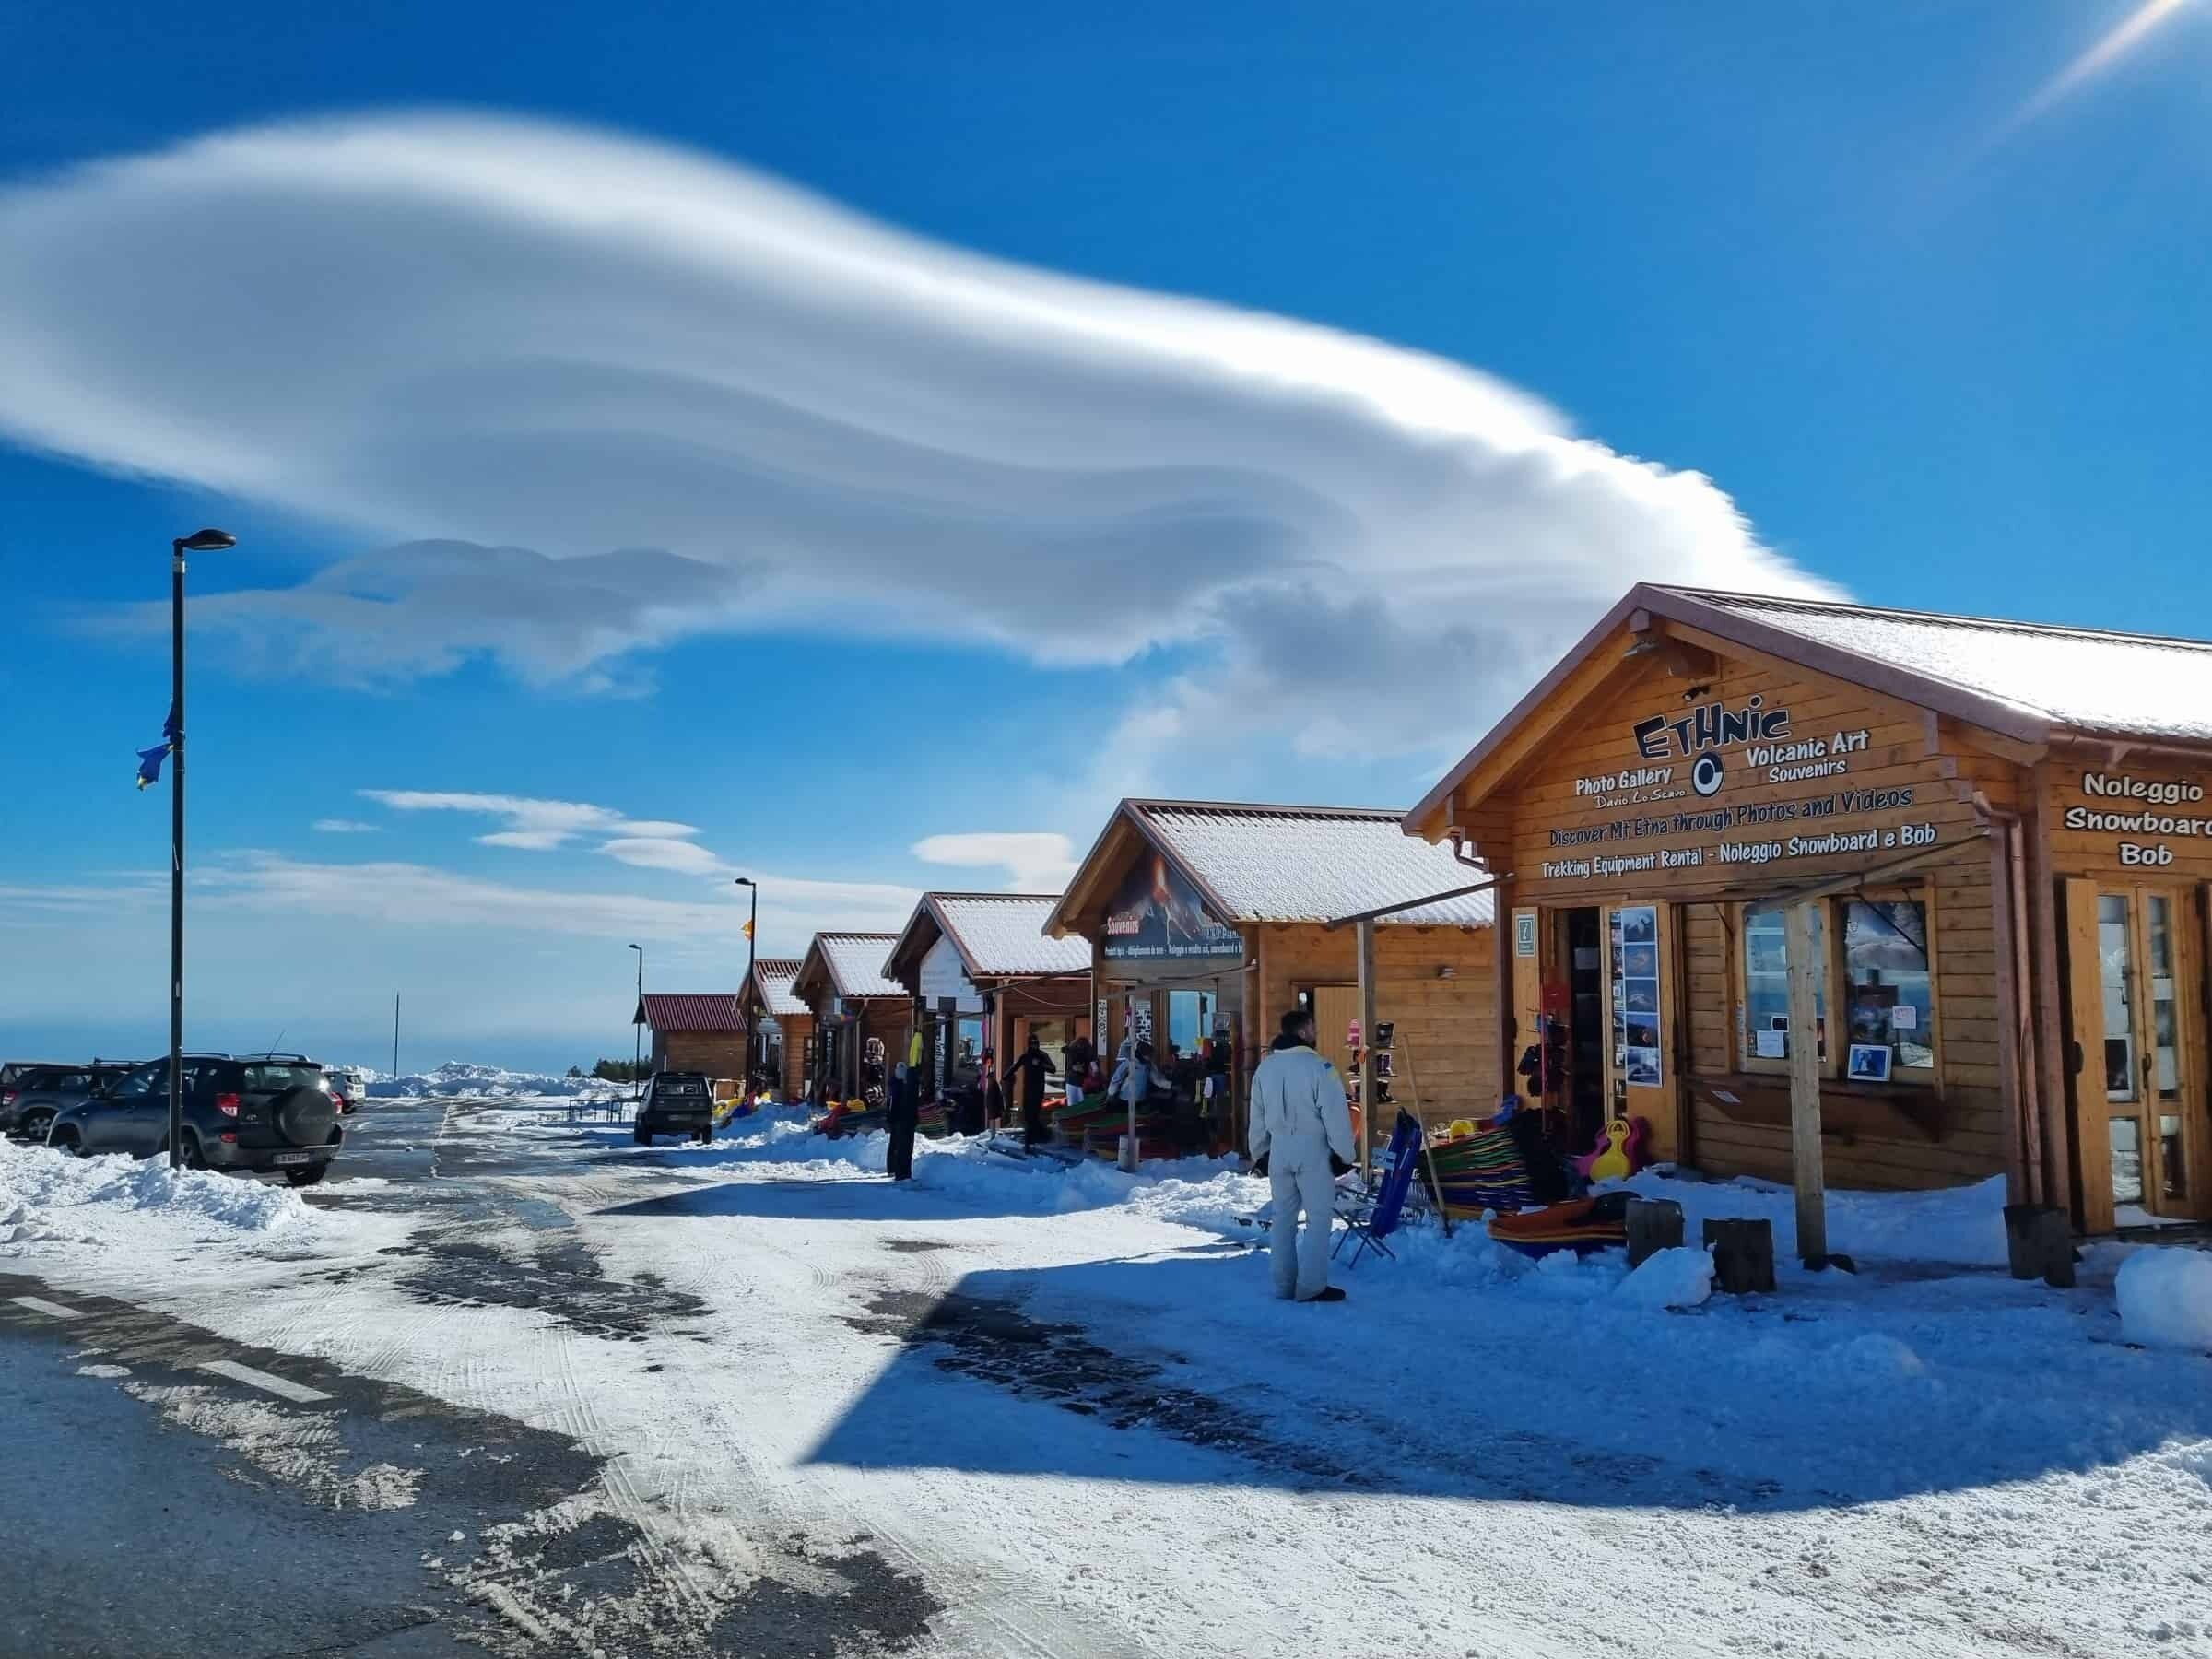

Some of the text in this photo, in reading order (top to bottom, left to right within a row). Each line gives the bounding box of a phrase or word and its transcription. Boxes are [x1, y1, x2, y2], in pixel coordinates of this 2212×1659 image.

[1747, 730, 1869, 768] Volcanic Art
[1575, 767, 1674, 796] Photo Gallery
[1769, 759, 1846, 783] Souvenirs
[2084, 773, 2204, 805] Noleggio
[1549, 787, 1913, 848] Discover Mt Etna through Photos and Videos
[1541, 859, 1590, 879] Trekking
[1594, 853, 1656, 876] Equipment
[1661, 847, 1703, 868] Rental
[1719, 840, 1782, 864] Noleggio
[1788, 829, 1878, 856] Snowboard
[1884, 831, 1896, 848] e
[1901, 823, 1936, 846] Bob
[2119, 842, 2174, 865] Bob
[1107, 915, 1140, 935] Souvenirs
